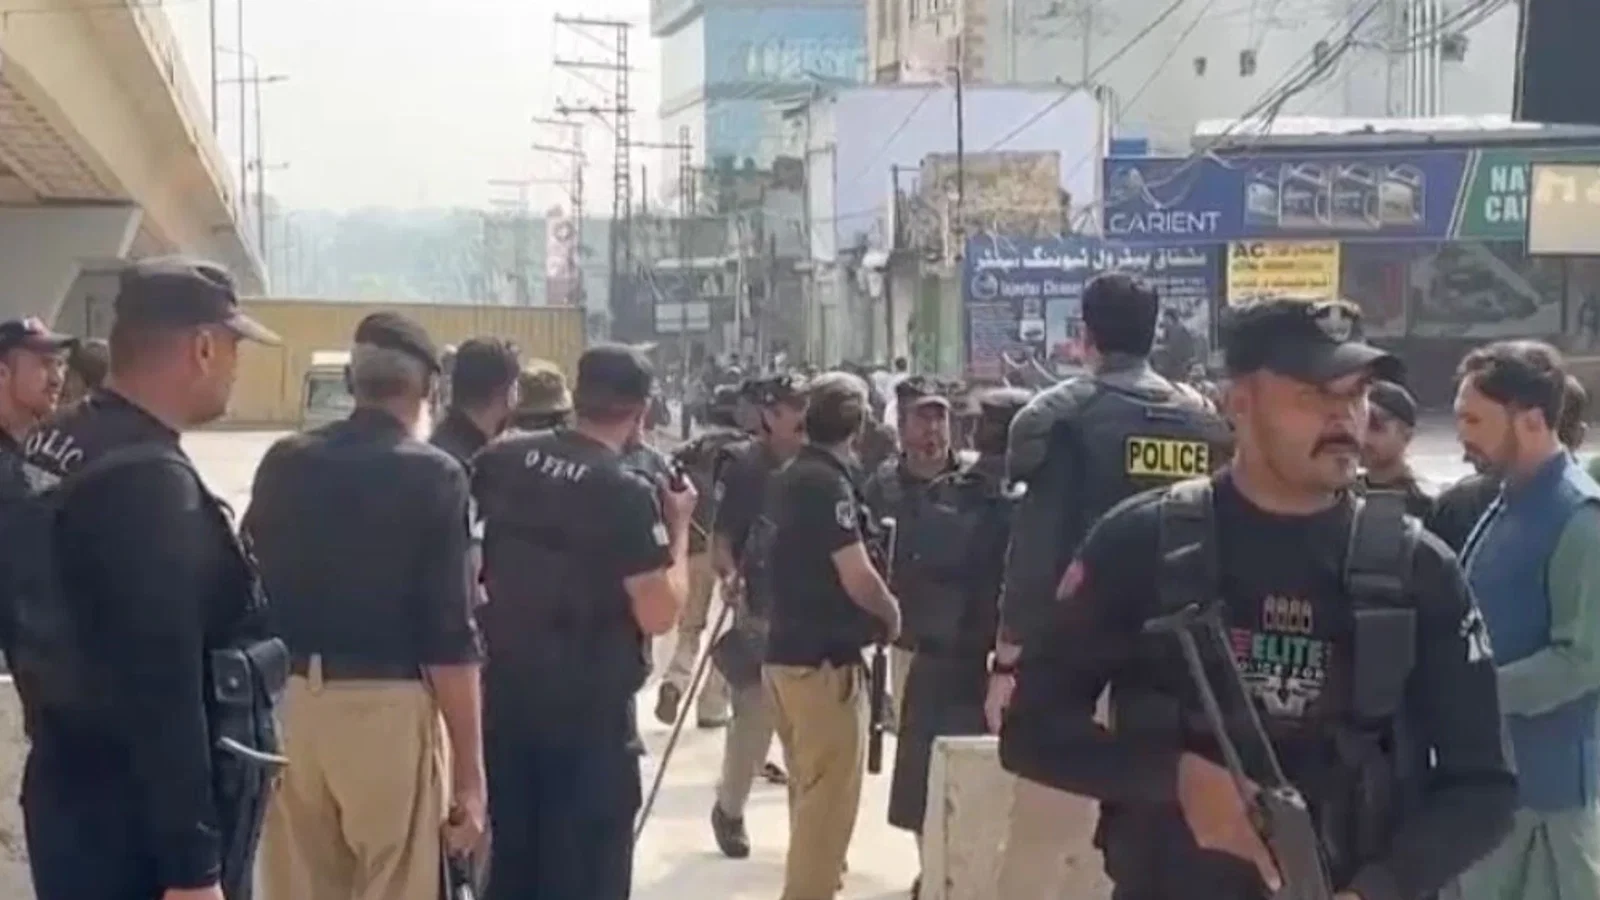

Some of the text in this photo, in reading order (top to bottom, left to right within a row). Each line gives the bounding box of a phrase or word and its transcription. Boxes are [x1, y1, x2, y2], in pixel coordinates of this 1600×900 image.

[1490, 165, 1529, 193] NA
[1109, 211, 1222, 234] CARIENT
[1233, 243, 1265, 259] AC
[1129, 441, 1206, 474] POLICE
[1252, 633, 1323, 669] ELITE
